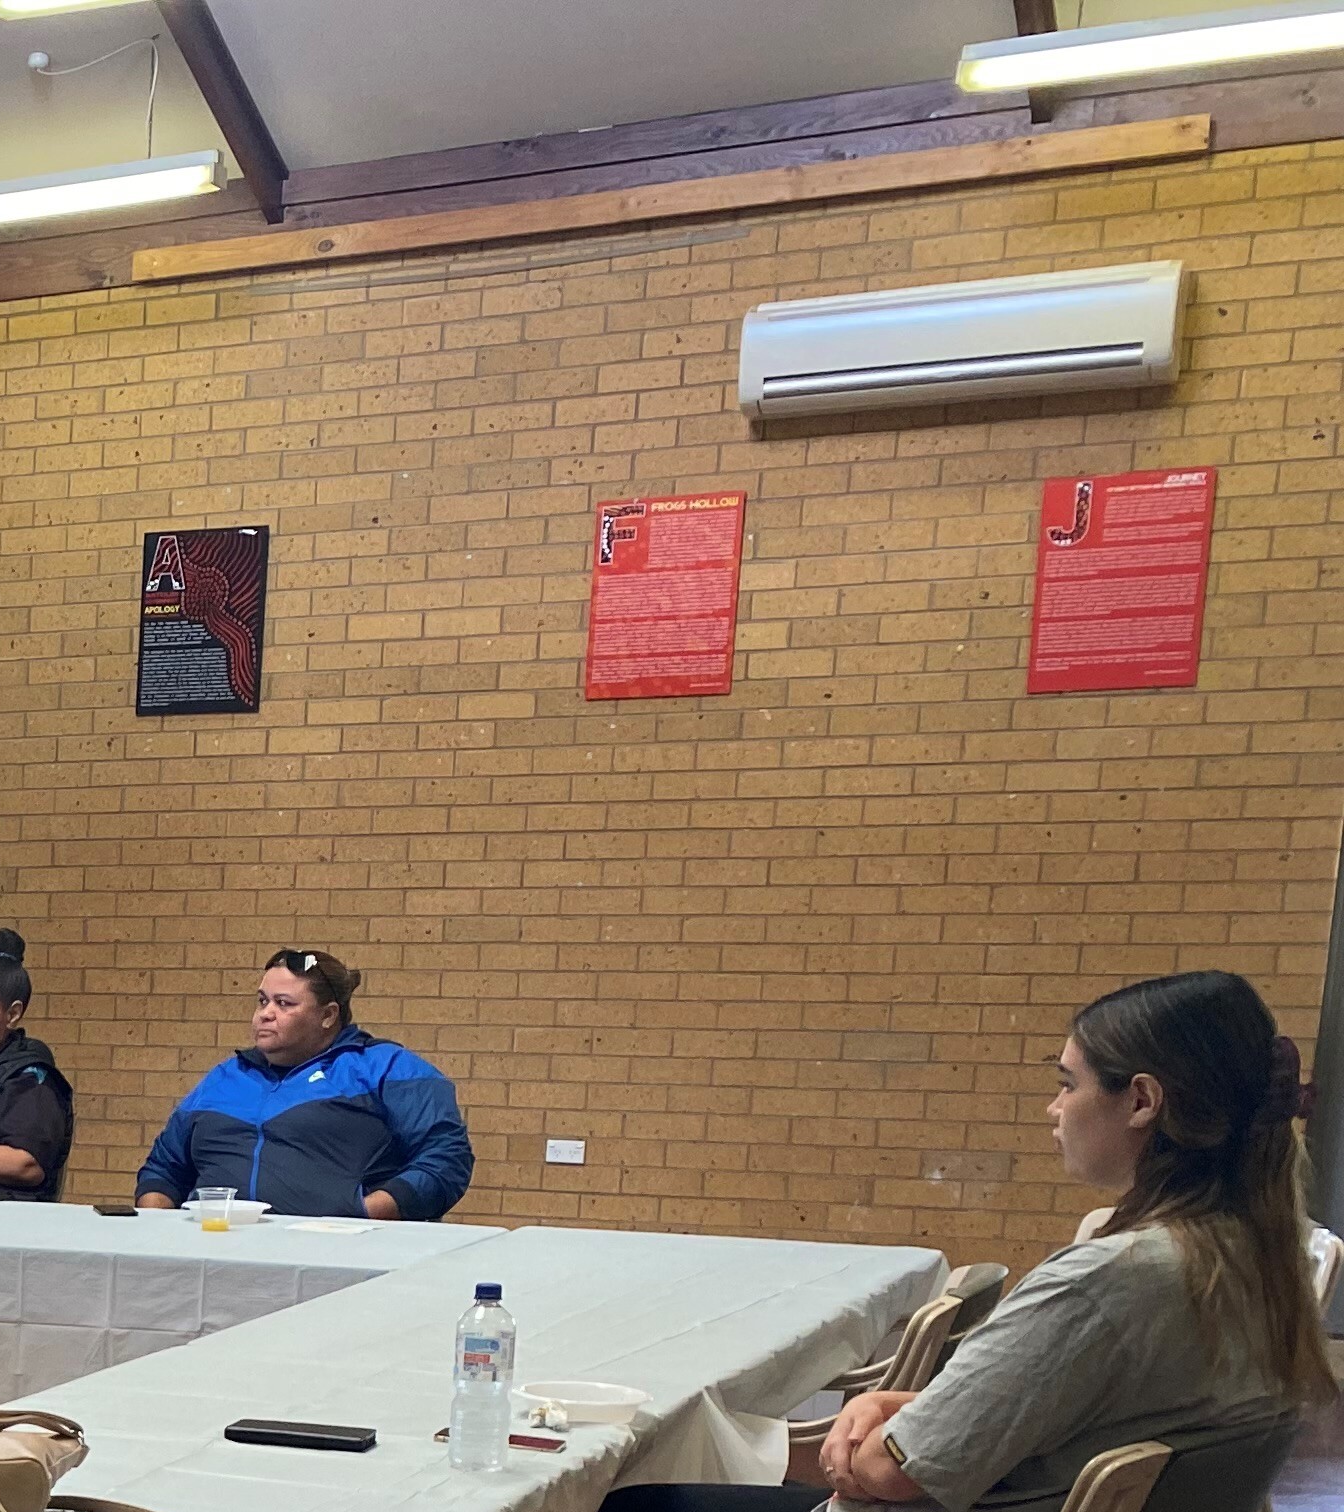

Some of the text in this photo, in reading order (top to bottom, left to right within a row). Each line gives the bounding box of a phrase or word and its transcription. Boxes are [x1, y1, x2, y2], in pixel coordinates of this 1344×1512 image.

[651, 496, 738, 512] FROGS HOLLOW
[598, 503, 646, 566] F
[145, 535, 185, 591] A
[144, 605, 180, 614] APOLOGY
